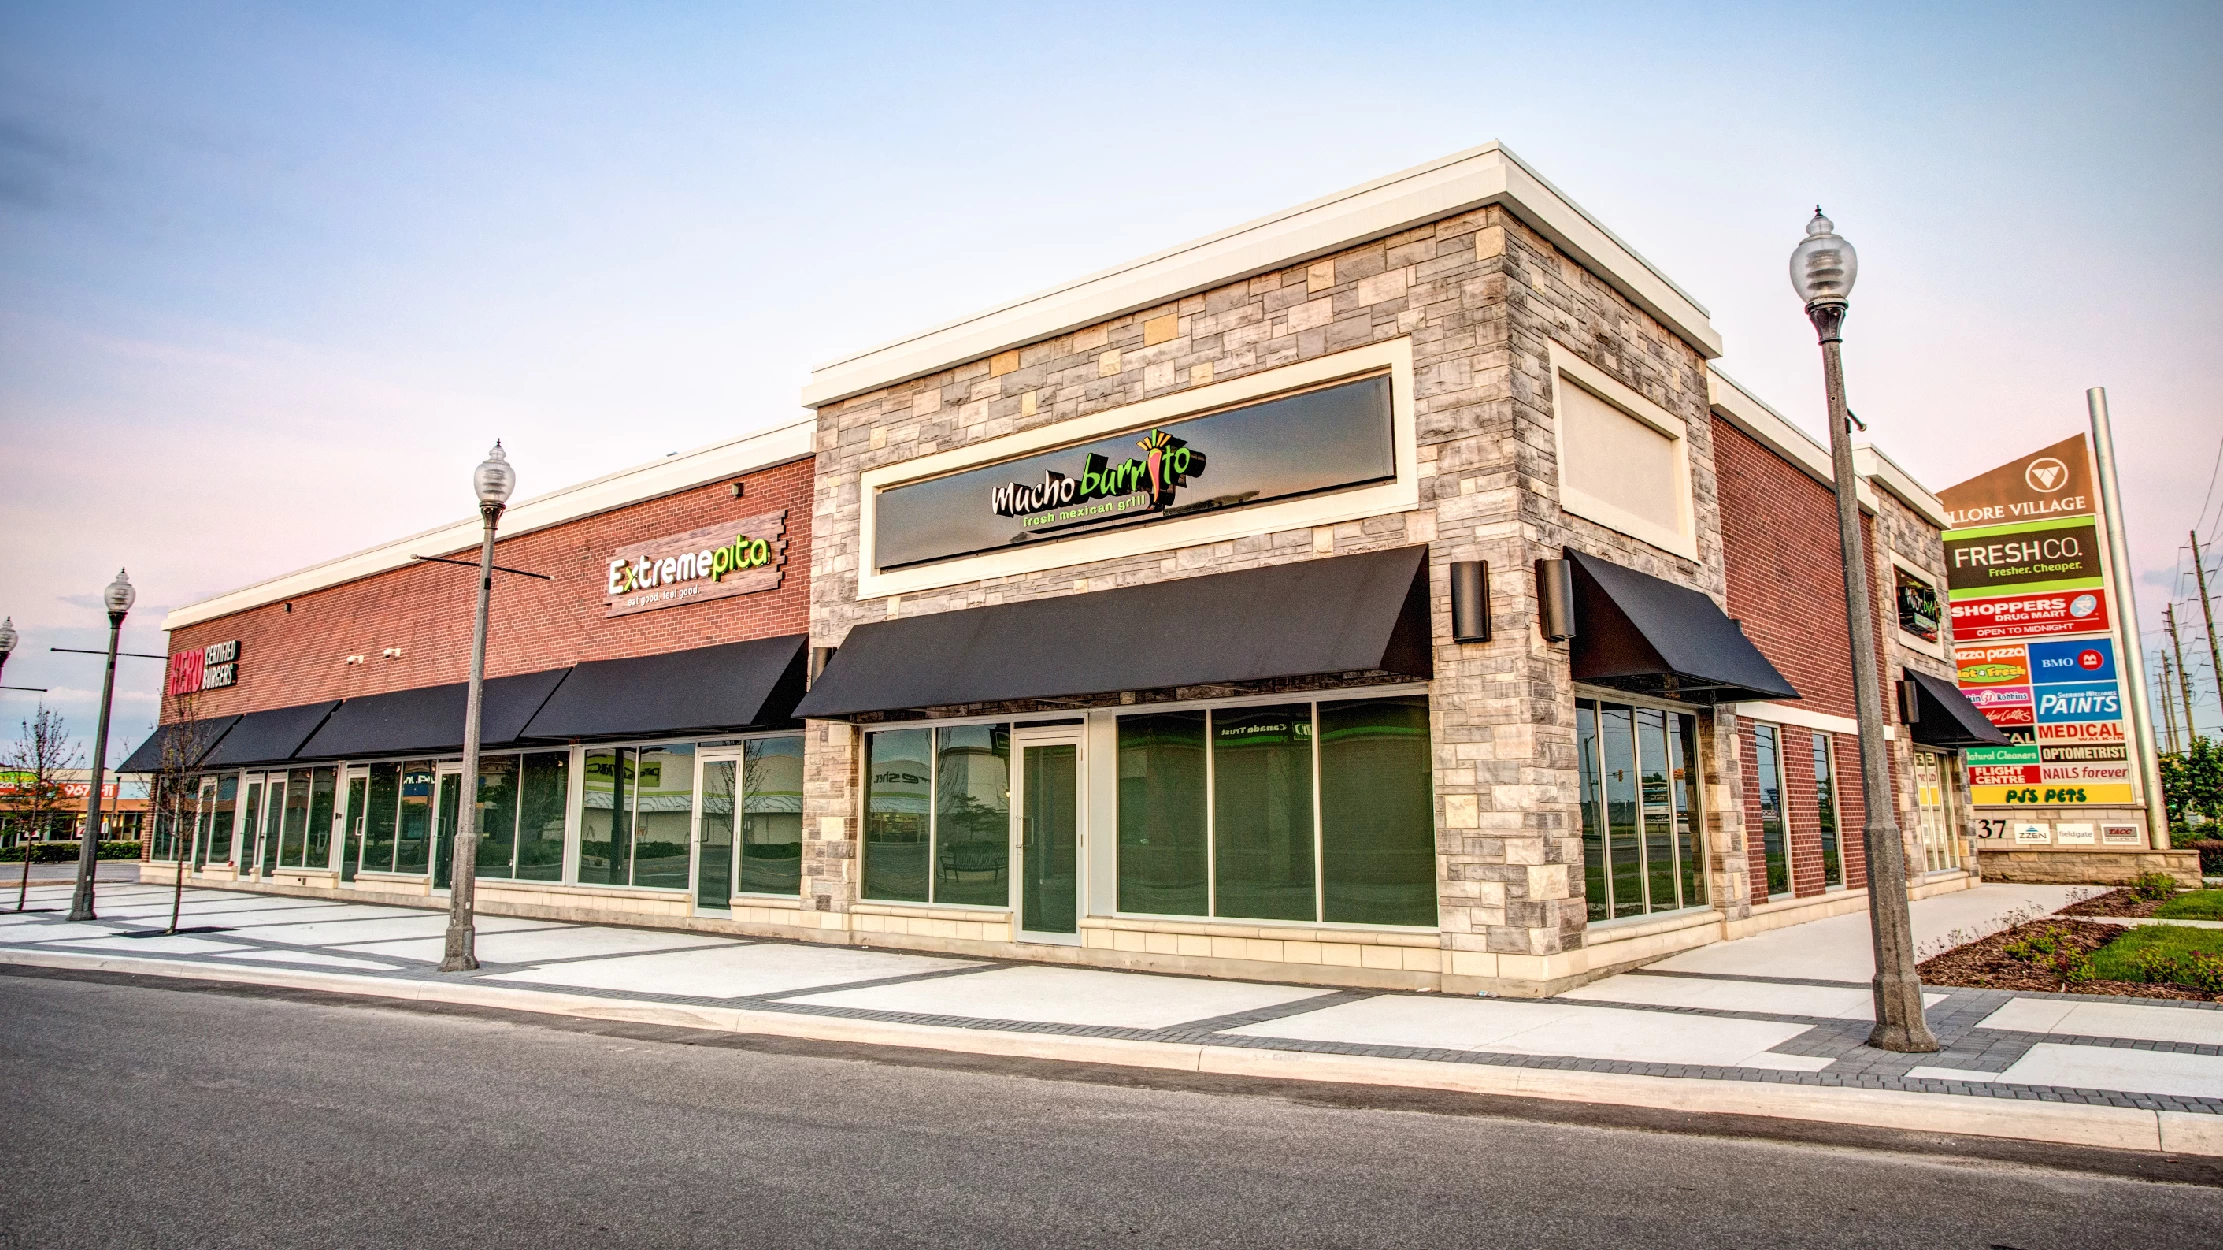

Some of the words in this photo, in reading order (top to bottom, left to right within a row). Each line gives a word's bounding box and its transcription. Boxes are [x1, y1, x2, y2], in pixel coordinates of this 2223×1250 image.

[1023, 515, 1055, 527] fresh
[1059, 502, 1113, 520] mexican
[1118, 494, 1146, 511] grill
[1949, 506, 2005, 523] LLORE
[2008, 496, 2086, 516] VILLAGE
[1988, 566, 2032, 577] Fresher.
[2033, 562, 2083, 573] Cheaper.
[1951, 598, 2066, 617] SHOPPERS
[1995, 613, 2029, 621] DRUG
[2032, 609, 2066, 618] MART
[1977, 627, 2006, 636] OPEN
[2007, 625, 2021, 634] TO
[2023, 623, 2074, 632] MIDNIGHT
[1987, 647, 2026, 662] pizza
[2041, 657, 2074, 668] BMO
[168, 647, 205, 696] HERO
[1987, 666, 2026, 677] Fresh
[2040, 694, 2118, 714] PAINTS
[2038, 723, 2124, 738] MEDICAL
[1996, 751, 2037, 760] Cleaners
[2042, 746, 2126, 760] OPTOMETRIST
[1975, 766, 2024, 776] FLIGHT
[2043, 767, 2079, 779] NAILS
[2082, 766, 2128, 778] forever
[1975, 775, 2026, 784] CENTRE
